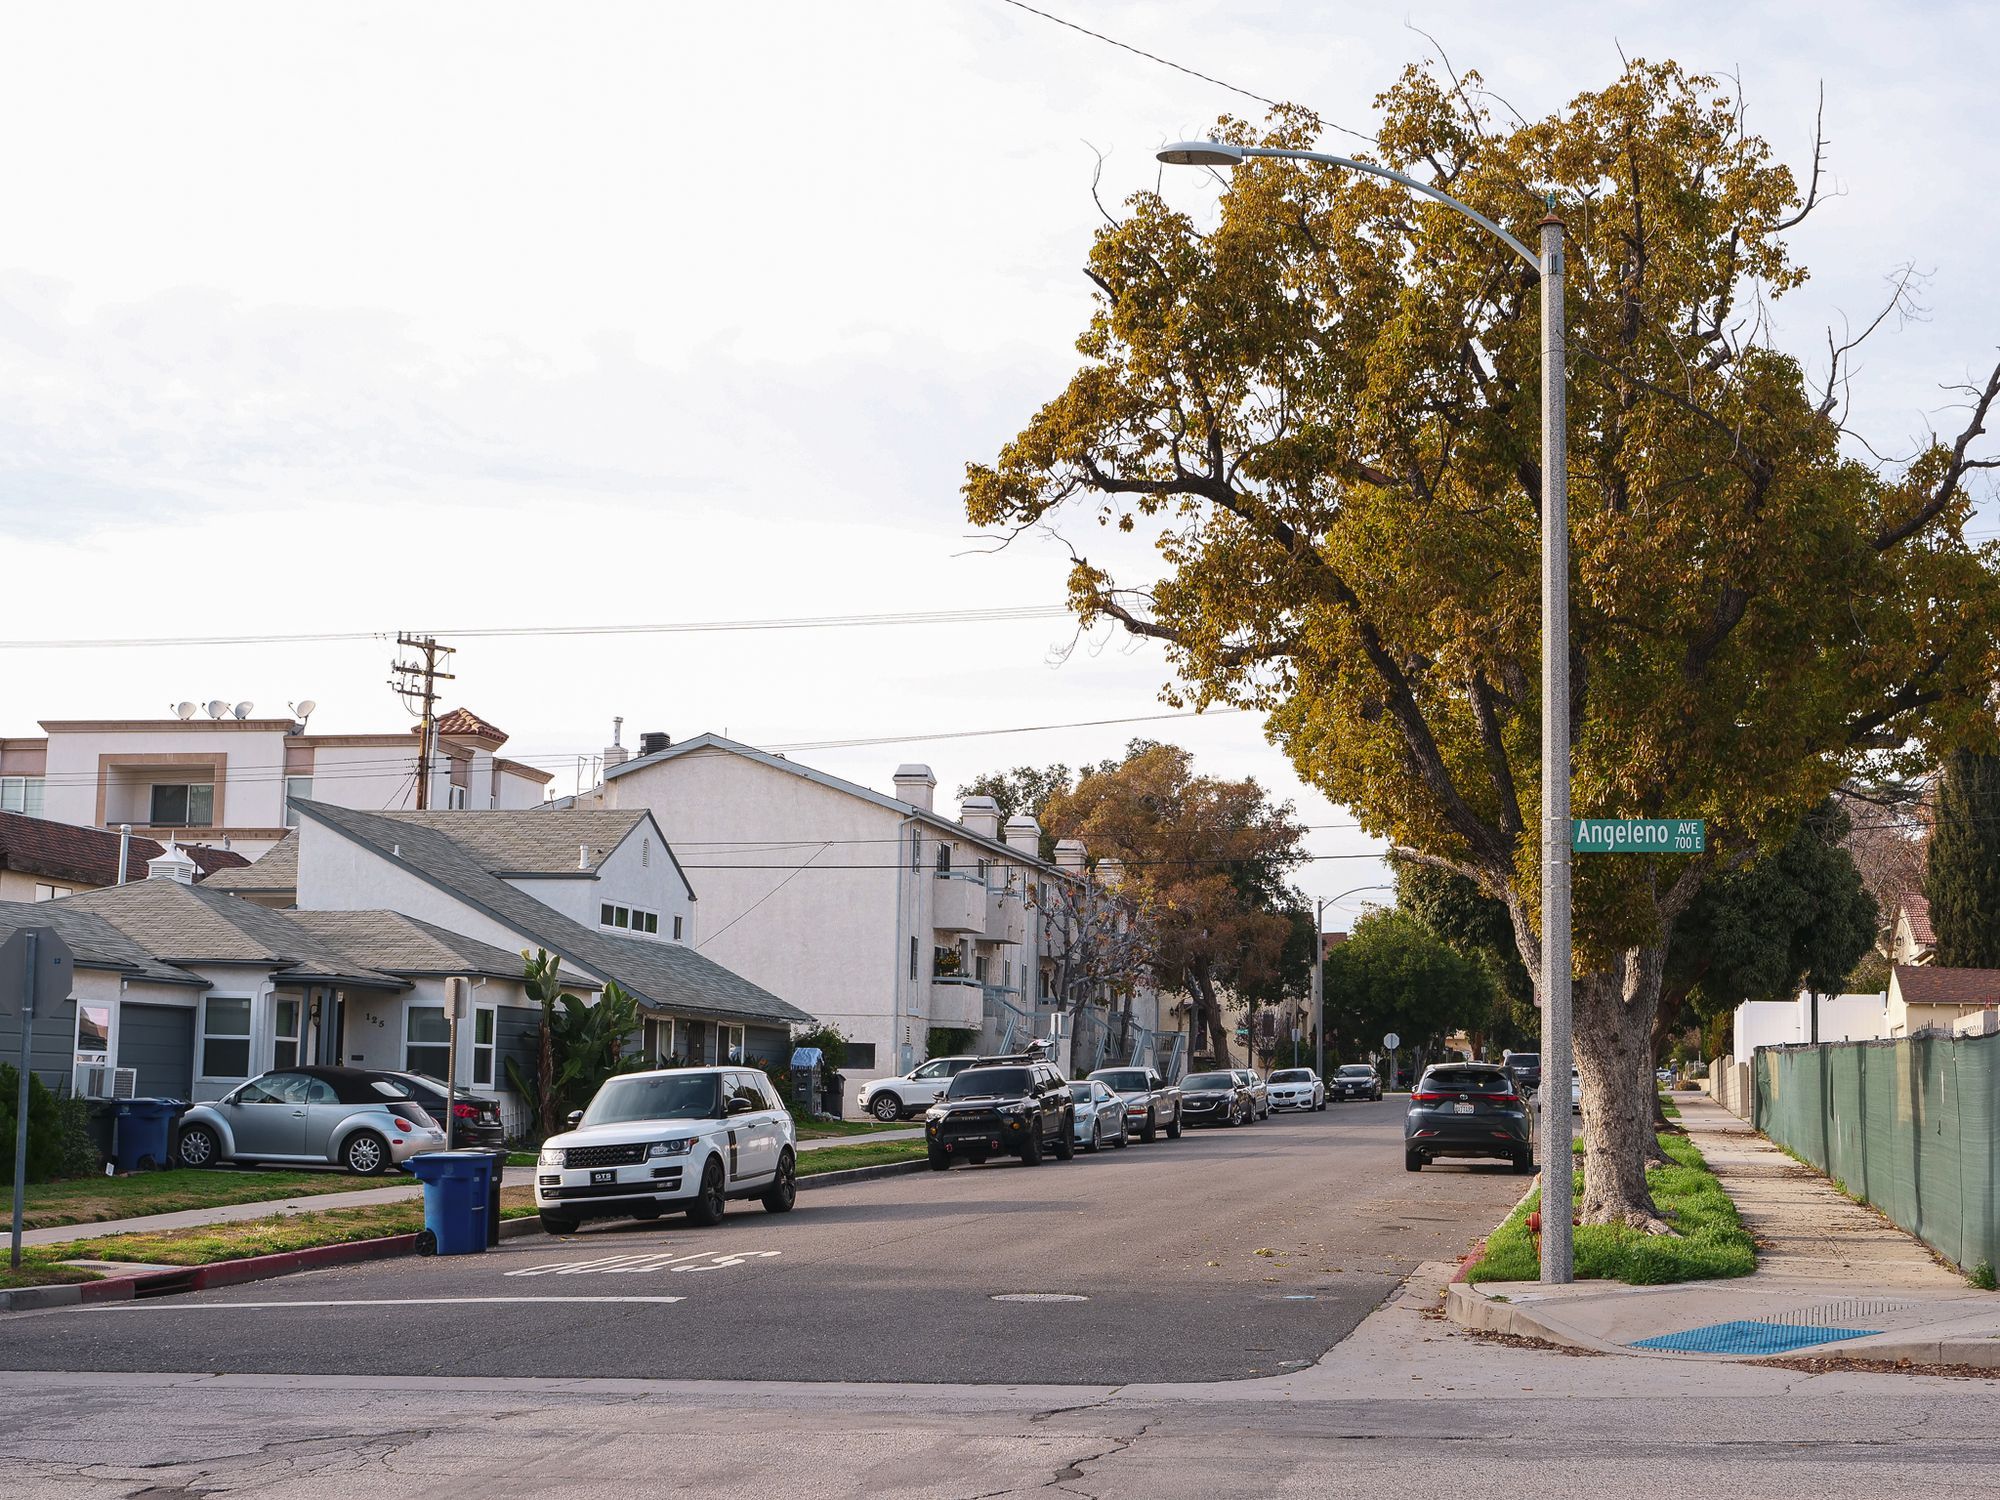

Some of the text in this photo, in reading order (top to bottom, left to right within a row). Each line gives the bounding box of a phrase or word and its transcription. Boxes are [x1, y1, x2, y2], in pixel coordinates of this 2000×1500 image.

[1678, 823, 1698, 834] AVE
[1577, 821, 1669, 850] Angeleno
[1675, 837, 1701, 849] 700 E
